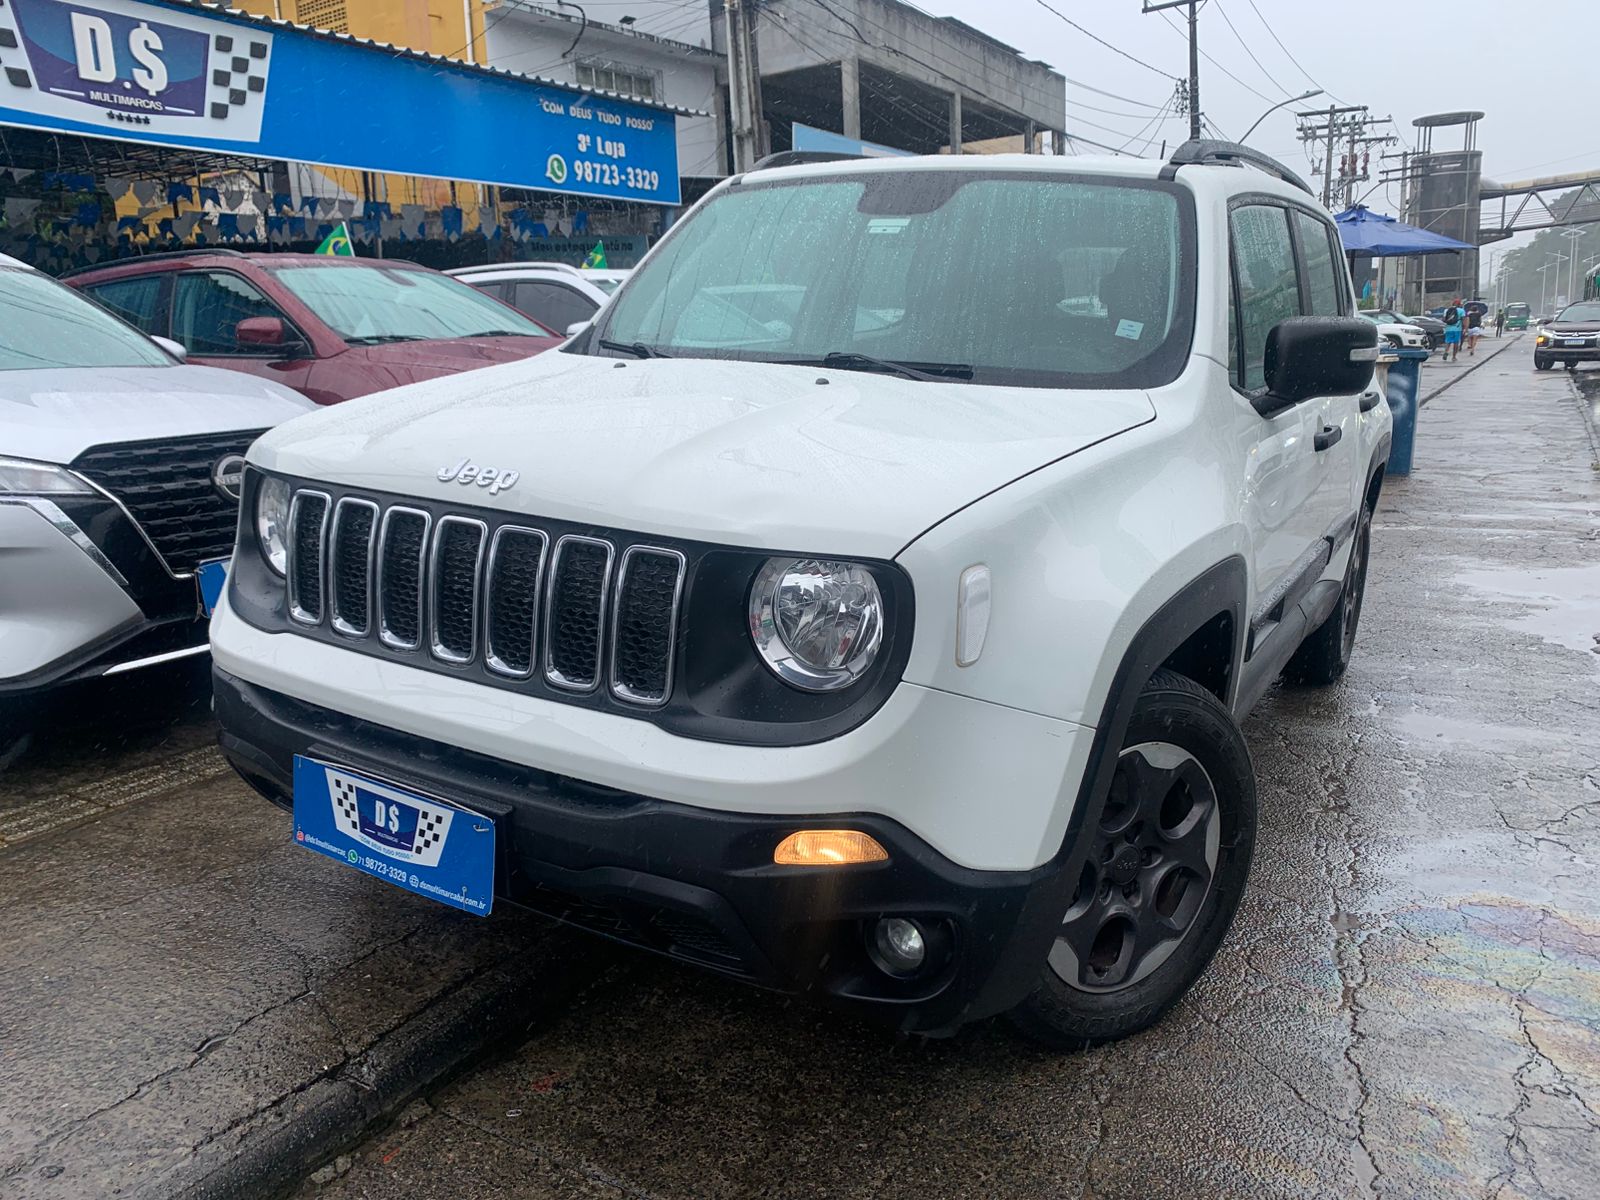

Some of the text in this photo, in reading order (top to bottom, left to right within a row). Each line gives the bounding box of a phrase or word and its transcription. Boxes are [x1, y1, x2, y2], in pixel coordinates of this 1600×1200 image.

[89, 90, 164, 112] MULTIMARCAS
[569, 105, 592, 120] DEUS
[596, 111, 621, 126] TUDO
[577, 133, 626, 159] 3ª Loja
[574, 160, 659, 191] 98723-3329
[437, 457, 520, 496] Jeep
